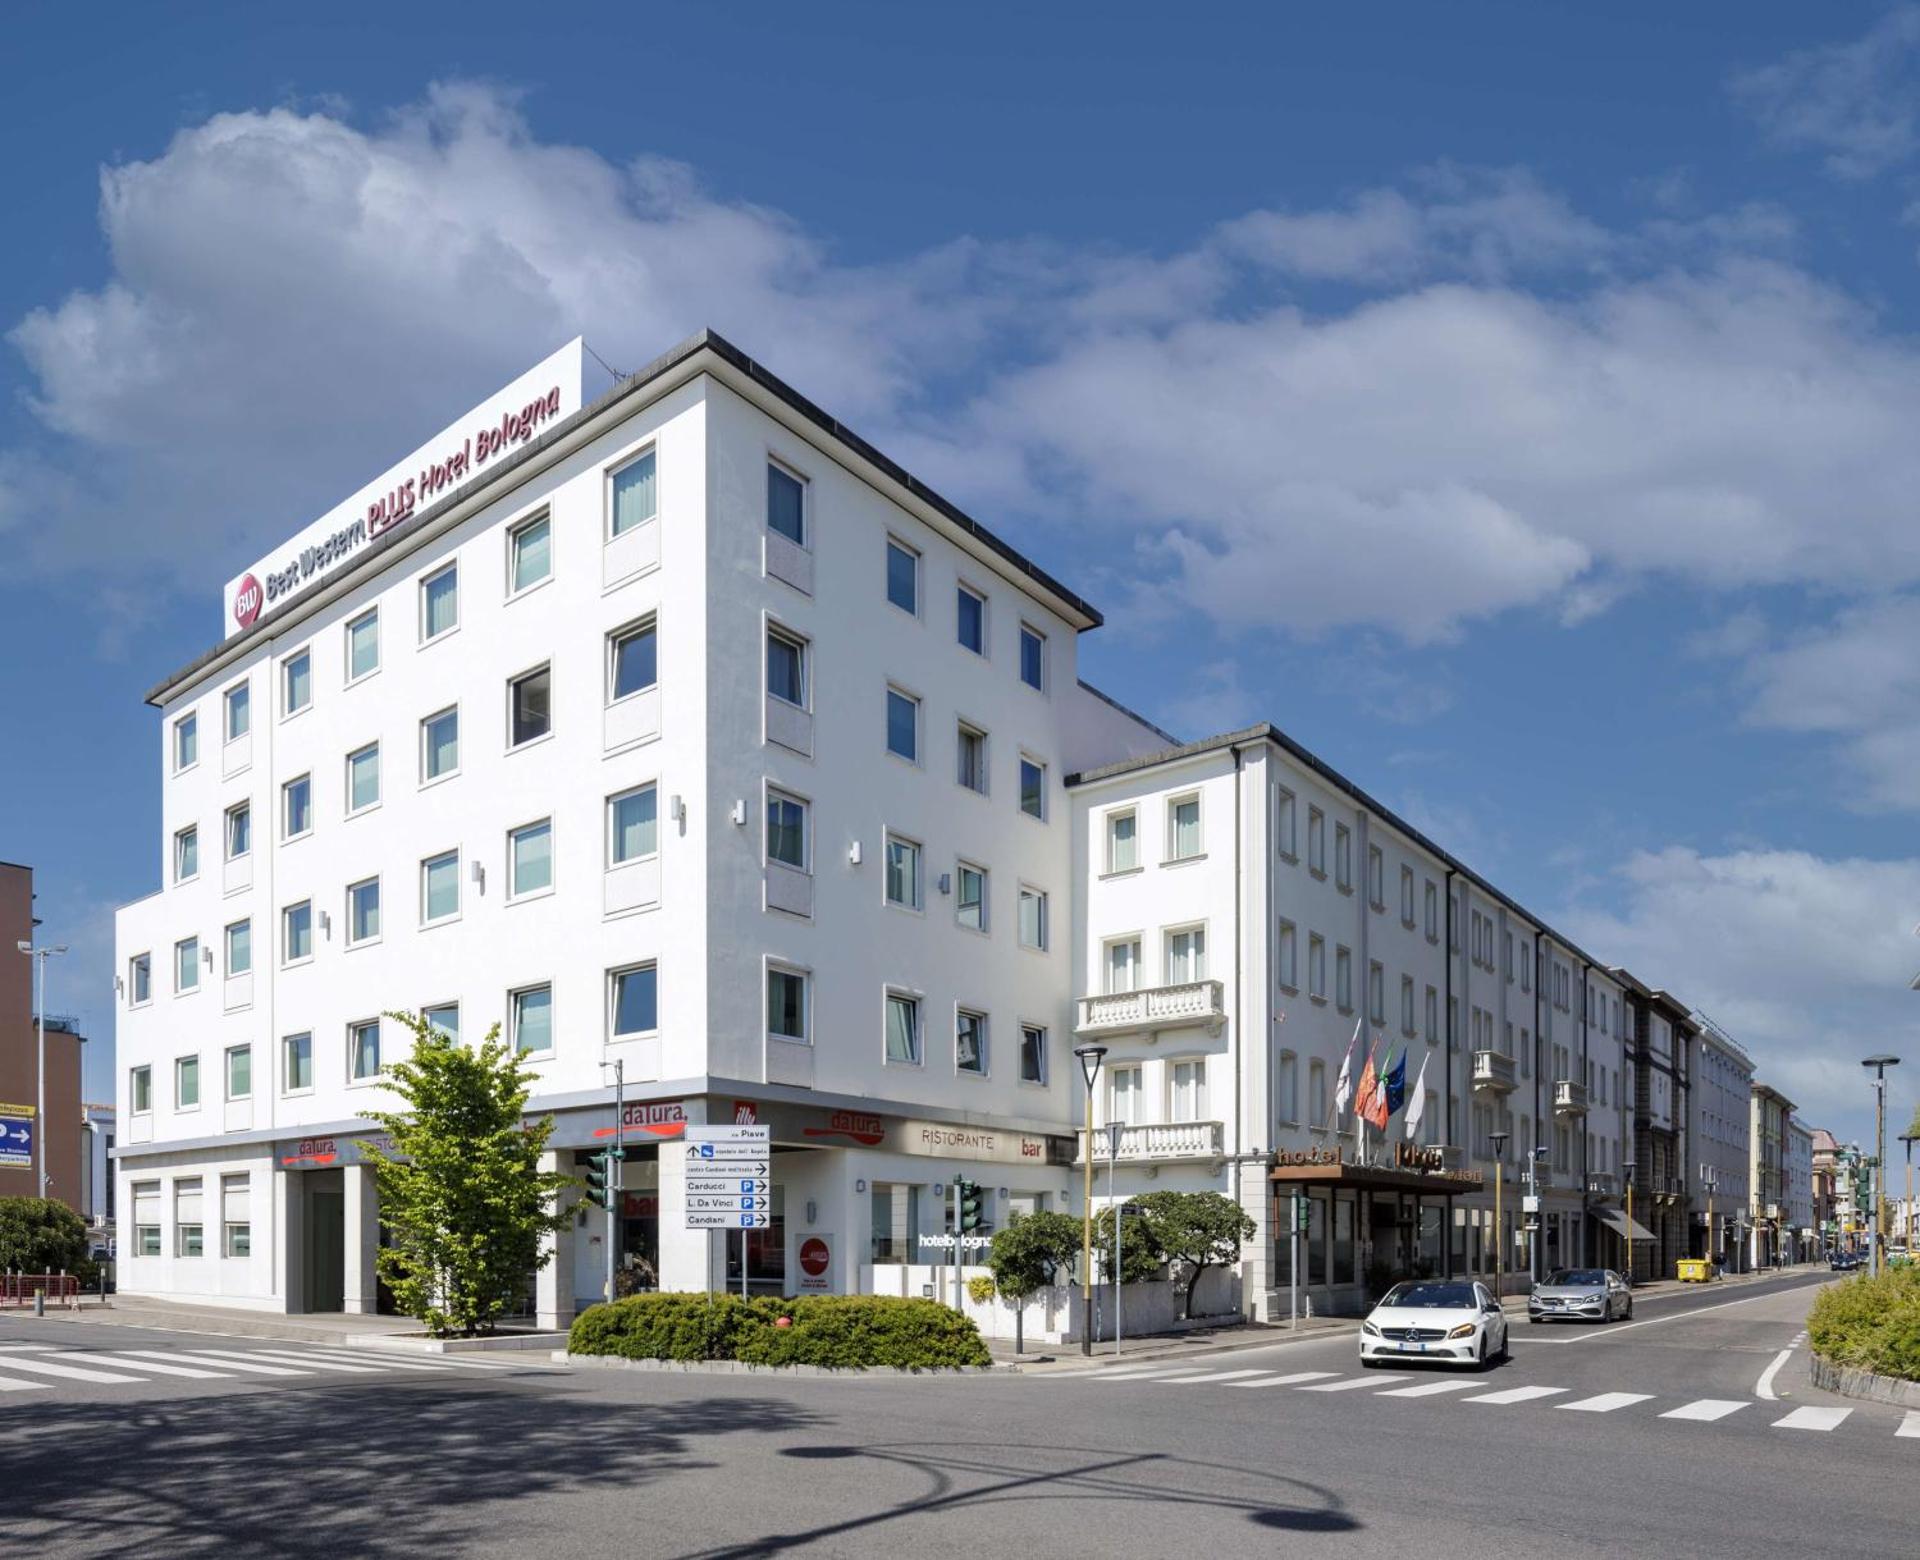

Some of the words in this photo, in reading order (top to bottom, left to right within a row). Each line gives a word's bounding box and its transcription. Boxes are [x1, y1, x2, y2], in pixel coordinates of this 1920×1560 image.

[266, 573, 300, 602] Best
[299, 518, 366, 580] Western
[368, 478, 416, 534] PLUS
[419, 438, 471, 502] Hotel
[475, 385, 561, 464] Bologna
[237, 585, 258, 618] BW
[735, 1106, 756, 1125] illy
[741, 1129, 765, 1137] Piave
[922, 1129, 994, 1150] RISTORANTE
[1021, 1138, 1042, 1157] bar
[1278, 1145, 1342, 1164] hotel
[688, 1182, 726, 1190] Carducci
[697, 1199, 710, 1207] Da
[712, 1199, 733, 1207] Vinci
[688, 1216, 726, 1224] Candiani
